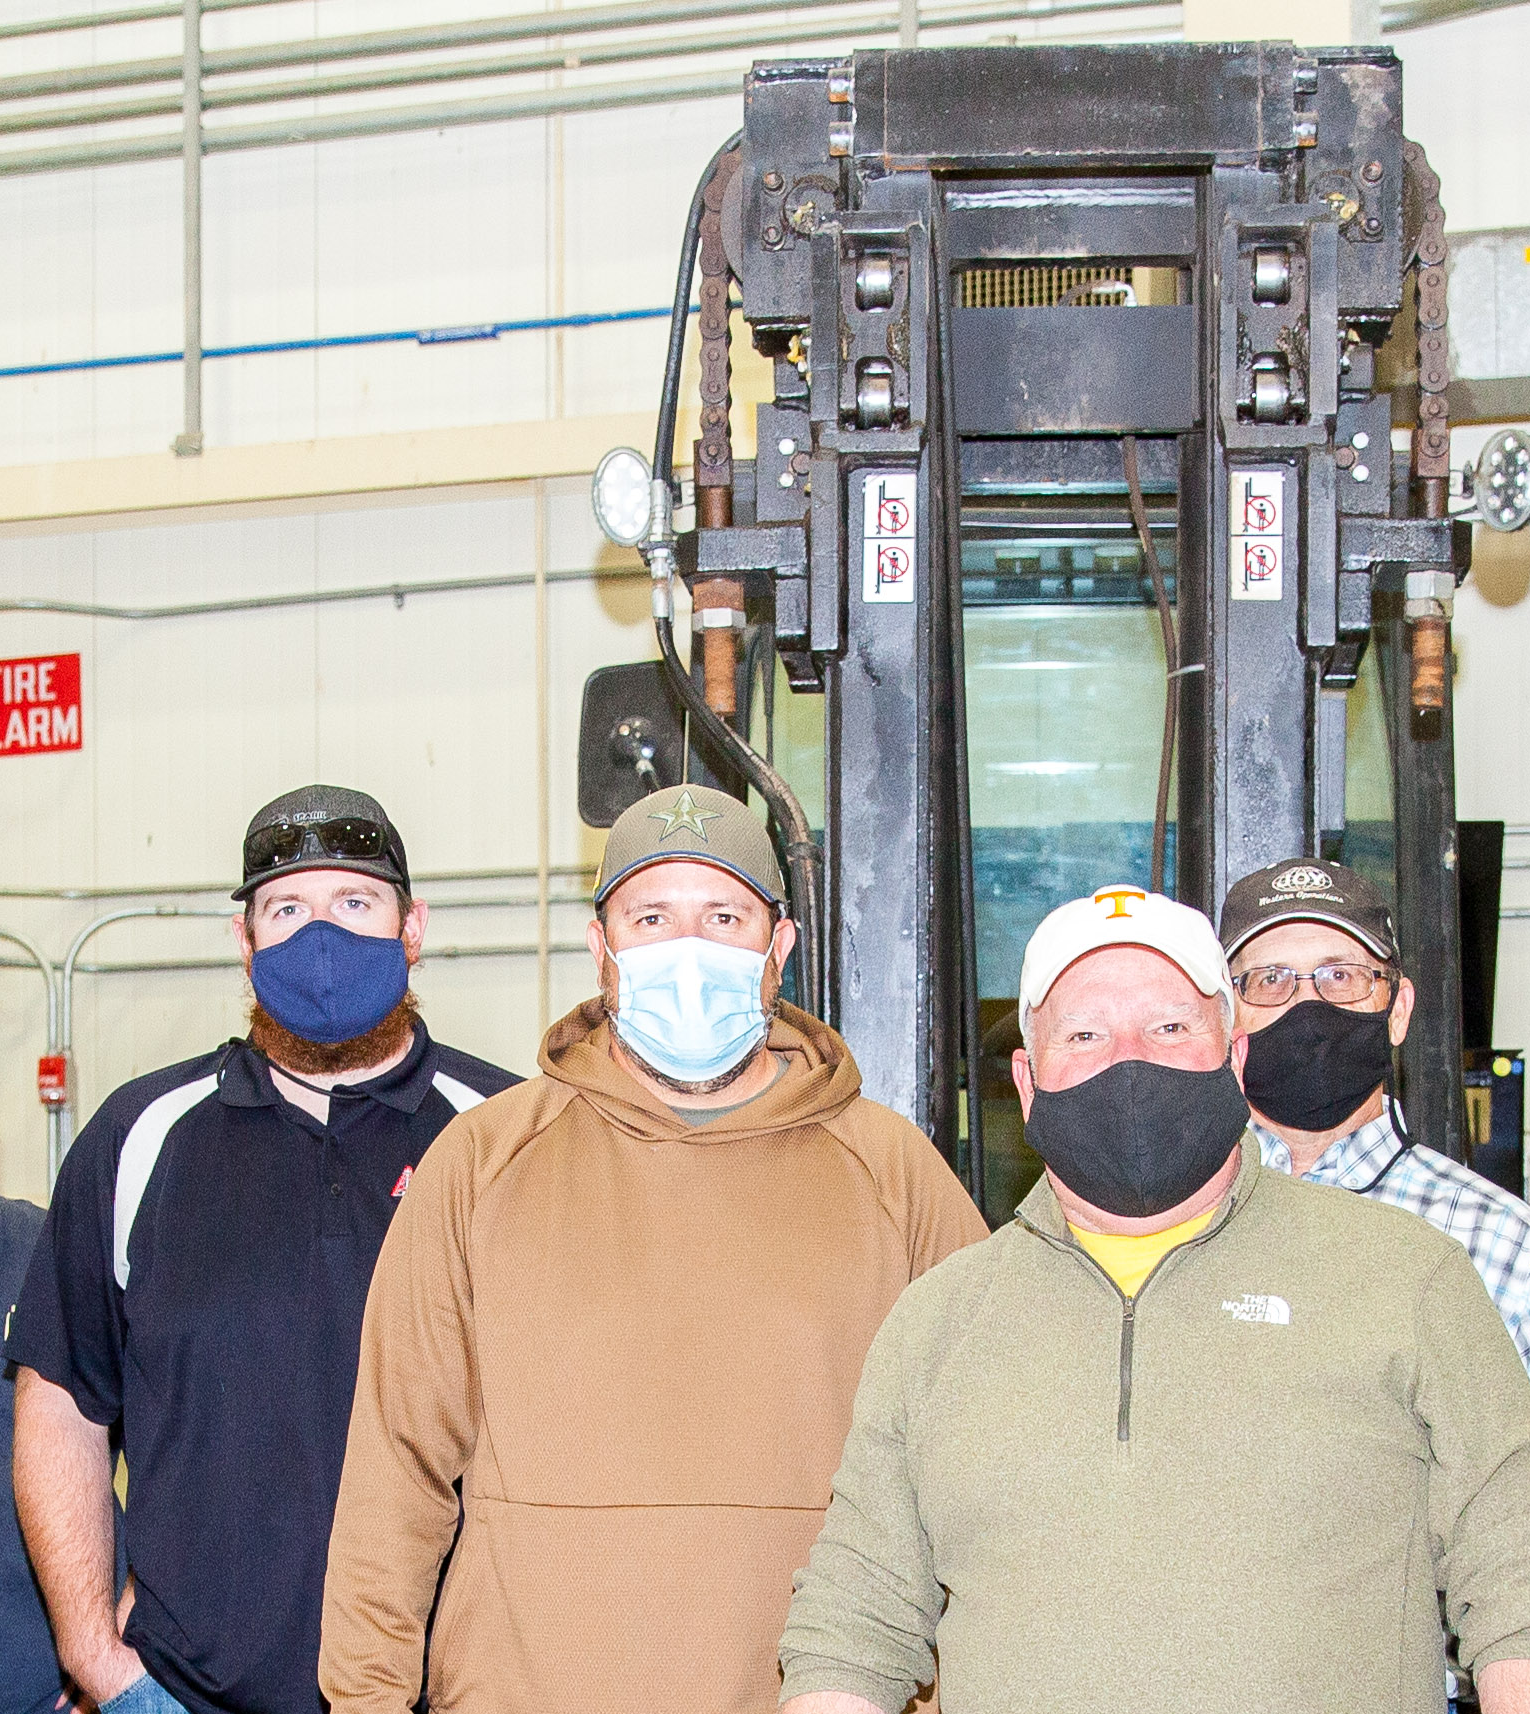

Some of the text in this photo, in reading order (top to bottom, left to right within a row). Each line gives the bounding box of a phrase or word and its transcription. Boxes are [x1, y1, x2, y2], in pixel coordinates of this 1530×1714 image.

[1258, 890, 1345, 907] Western Operations
[1095, 891, 1145, 920] T
[1241, 1293, 1269, 1304] THE
[1221, 1300, 1267, 1313] NORTH
[1232, 1311, 1265, 1322] FACE
